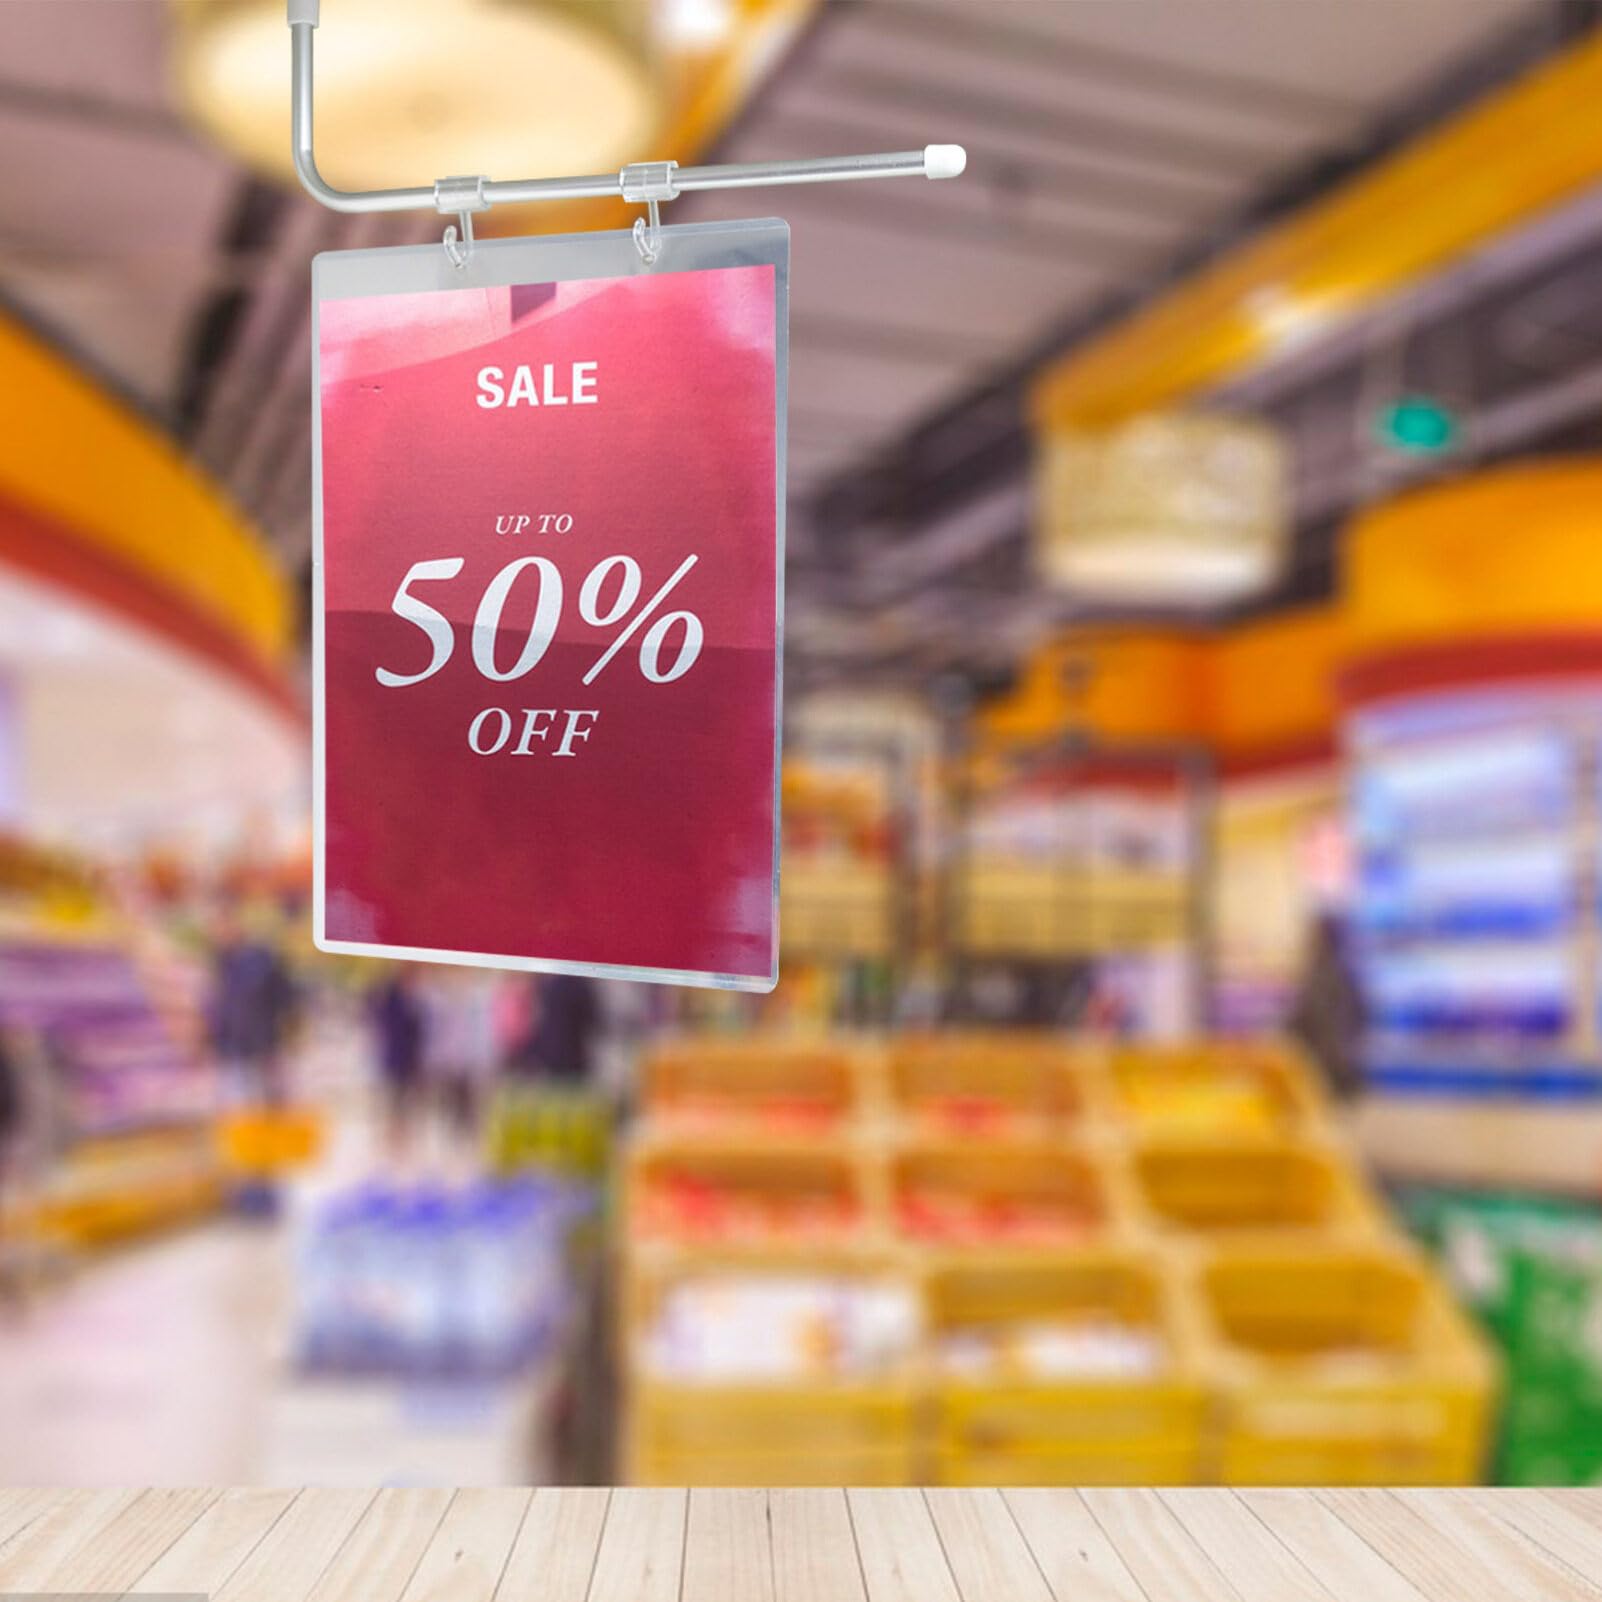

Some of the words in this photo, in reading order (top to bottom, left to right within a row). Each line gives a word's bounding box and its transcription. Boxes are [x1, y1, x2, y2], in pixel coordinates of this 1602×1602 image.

[476, 361, 598, 409] SALE
[495, 515, 531, 535] UP
[538, 514, 574, 534] TO
[376, 553, 704, 687] 50%
[468, 708, 598, 757] OFF
